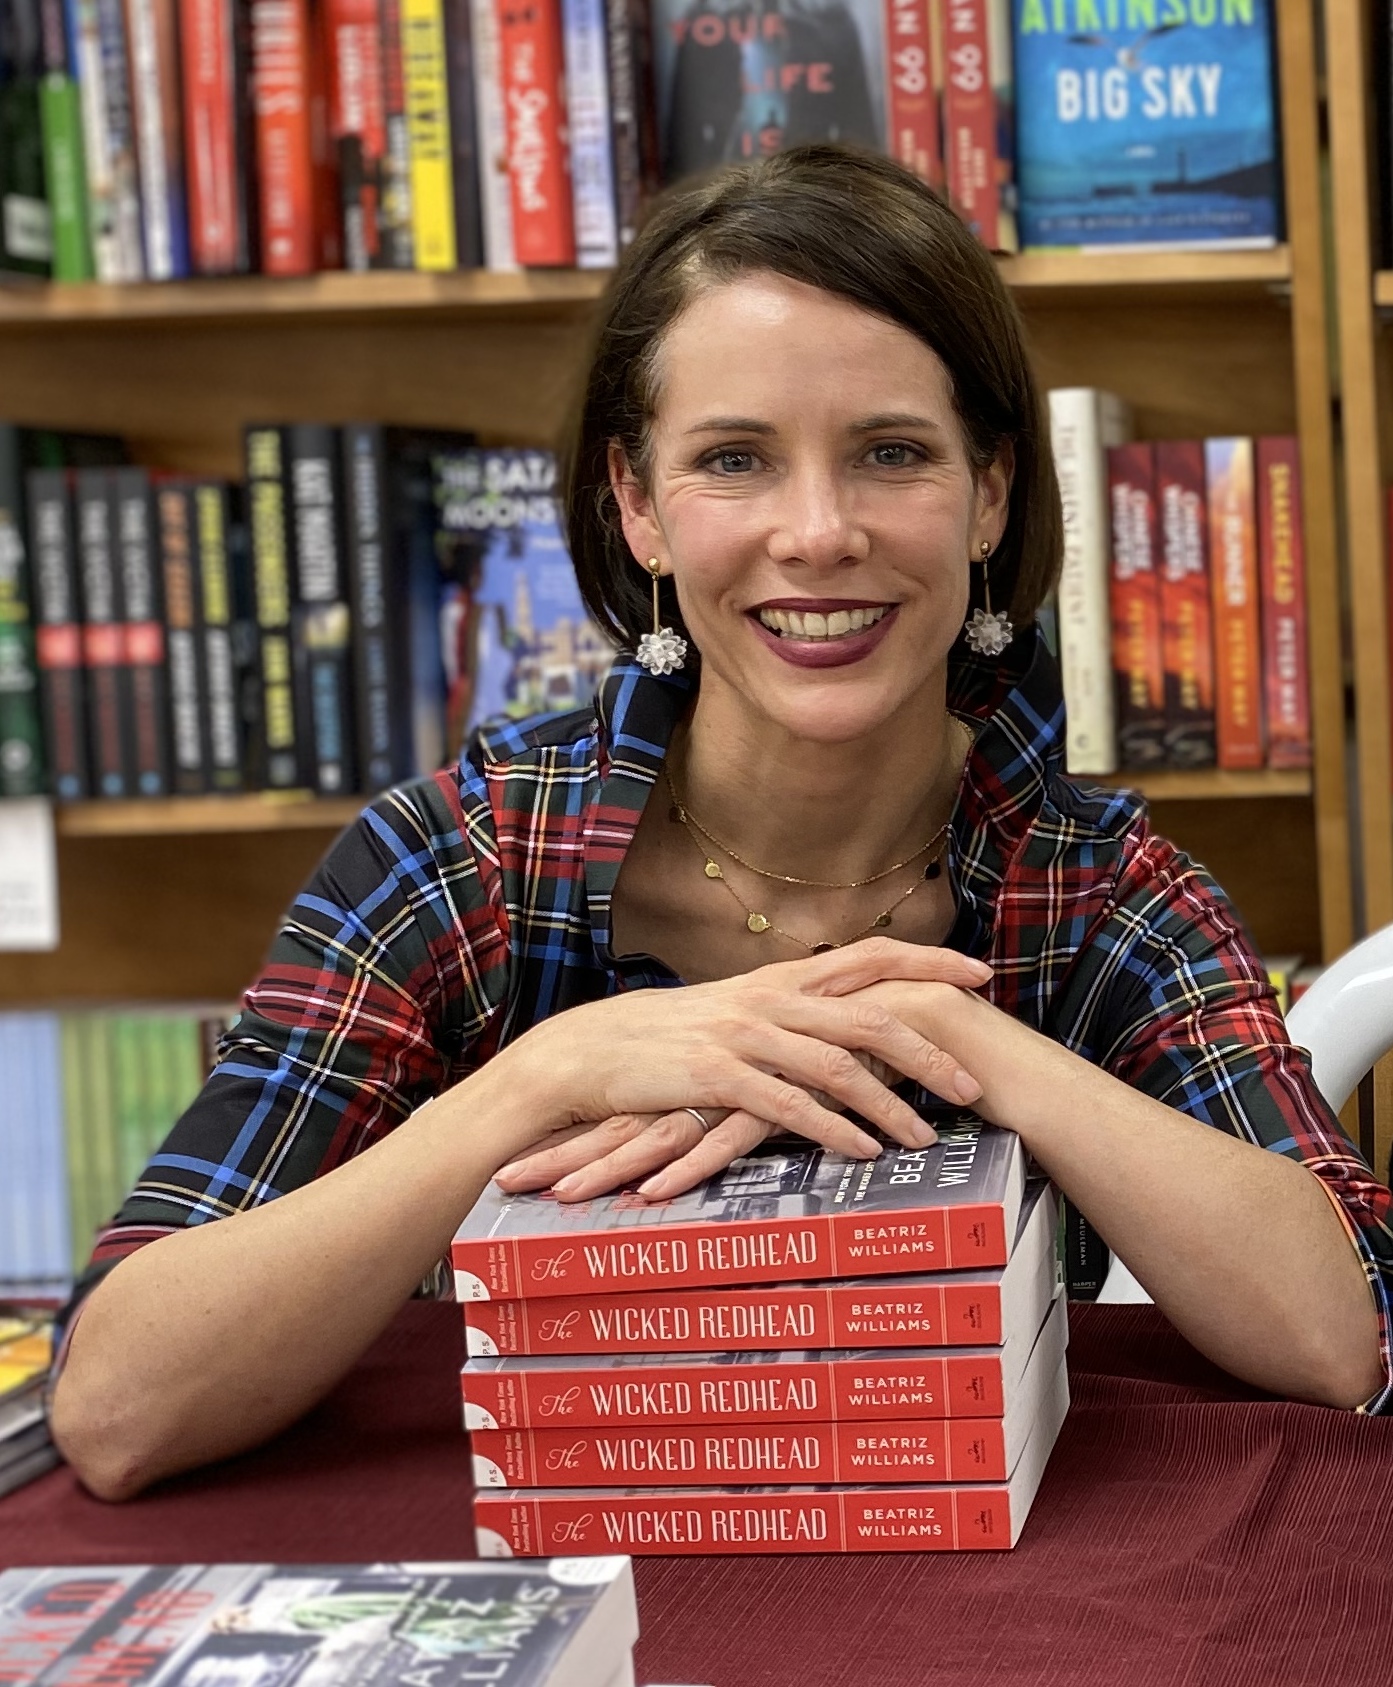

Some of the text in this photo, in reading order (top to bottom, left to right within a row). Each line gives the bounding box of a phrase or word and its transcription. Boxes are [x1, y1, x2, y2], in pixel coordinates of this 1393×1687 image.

[670, 12, 788, 47] YOUR
[1020, 0, 1253, 34] ATKINSON
[893, 0, 926, 94] N 99
[948, 0, 983, 92] N 99
[741, 62, 834, 93] LIFE
[1056, 64, 1222, 122] BIG SKY
[442, 499, 557, 529] MOONS
[1269, 462, 1294, 604] SNAKEHEAD
[1277, 617, 1296, 679] PETER
[937, 1114, 983, 1188] WILLIAMS
[848, 1241, 935, 1257] WILLIAMS
[853, 1224, 927, 1240] BEATRIZ
[1079, 1218, 1087, 1266] MEULEMAN
[531, 1231, 817, 1281] The WICKED REDHEAD
[538, 1304, 815, 1341] The WICKED REDHEAD
[846, 1319, 931, 1333] WILLIAMS
[851, 1303, 923, 1316] BEATRIZ
[538, 1378, 817, 1417] The WICKED REDHEAD
[848, 1392, 934, 1406] WILLIAMS
[853, 1376, 926, 1389] BEATRIZ
[546, 1437, 820, 1471] The WICKED REDHEAD
[851, 1453, 935, 1466] WILLIAMS
[856, 1437, 928, 1449] BEATRIZ
[552, 1508, 827, 1543] The WICKED REDHEAD
[858, 1524, 942, 1537] WILLIAMS
[863, 1508, 935, 1521] BEATRIZ
[0, 1583, 125, 1683] ICKED
